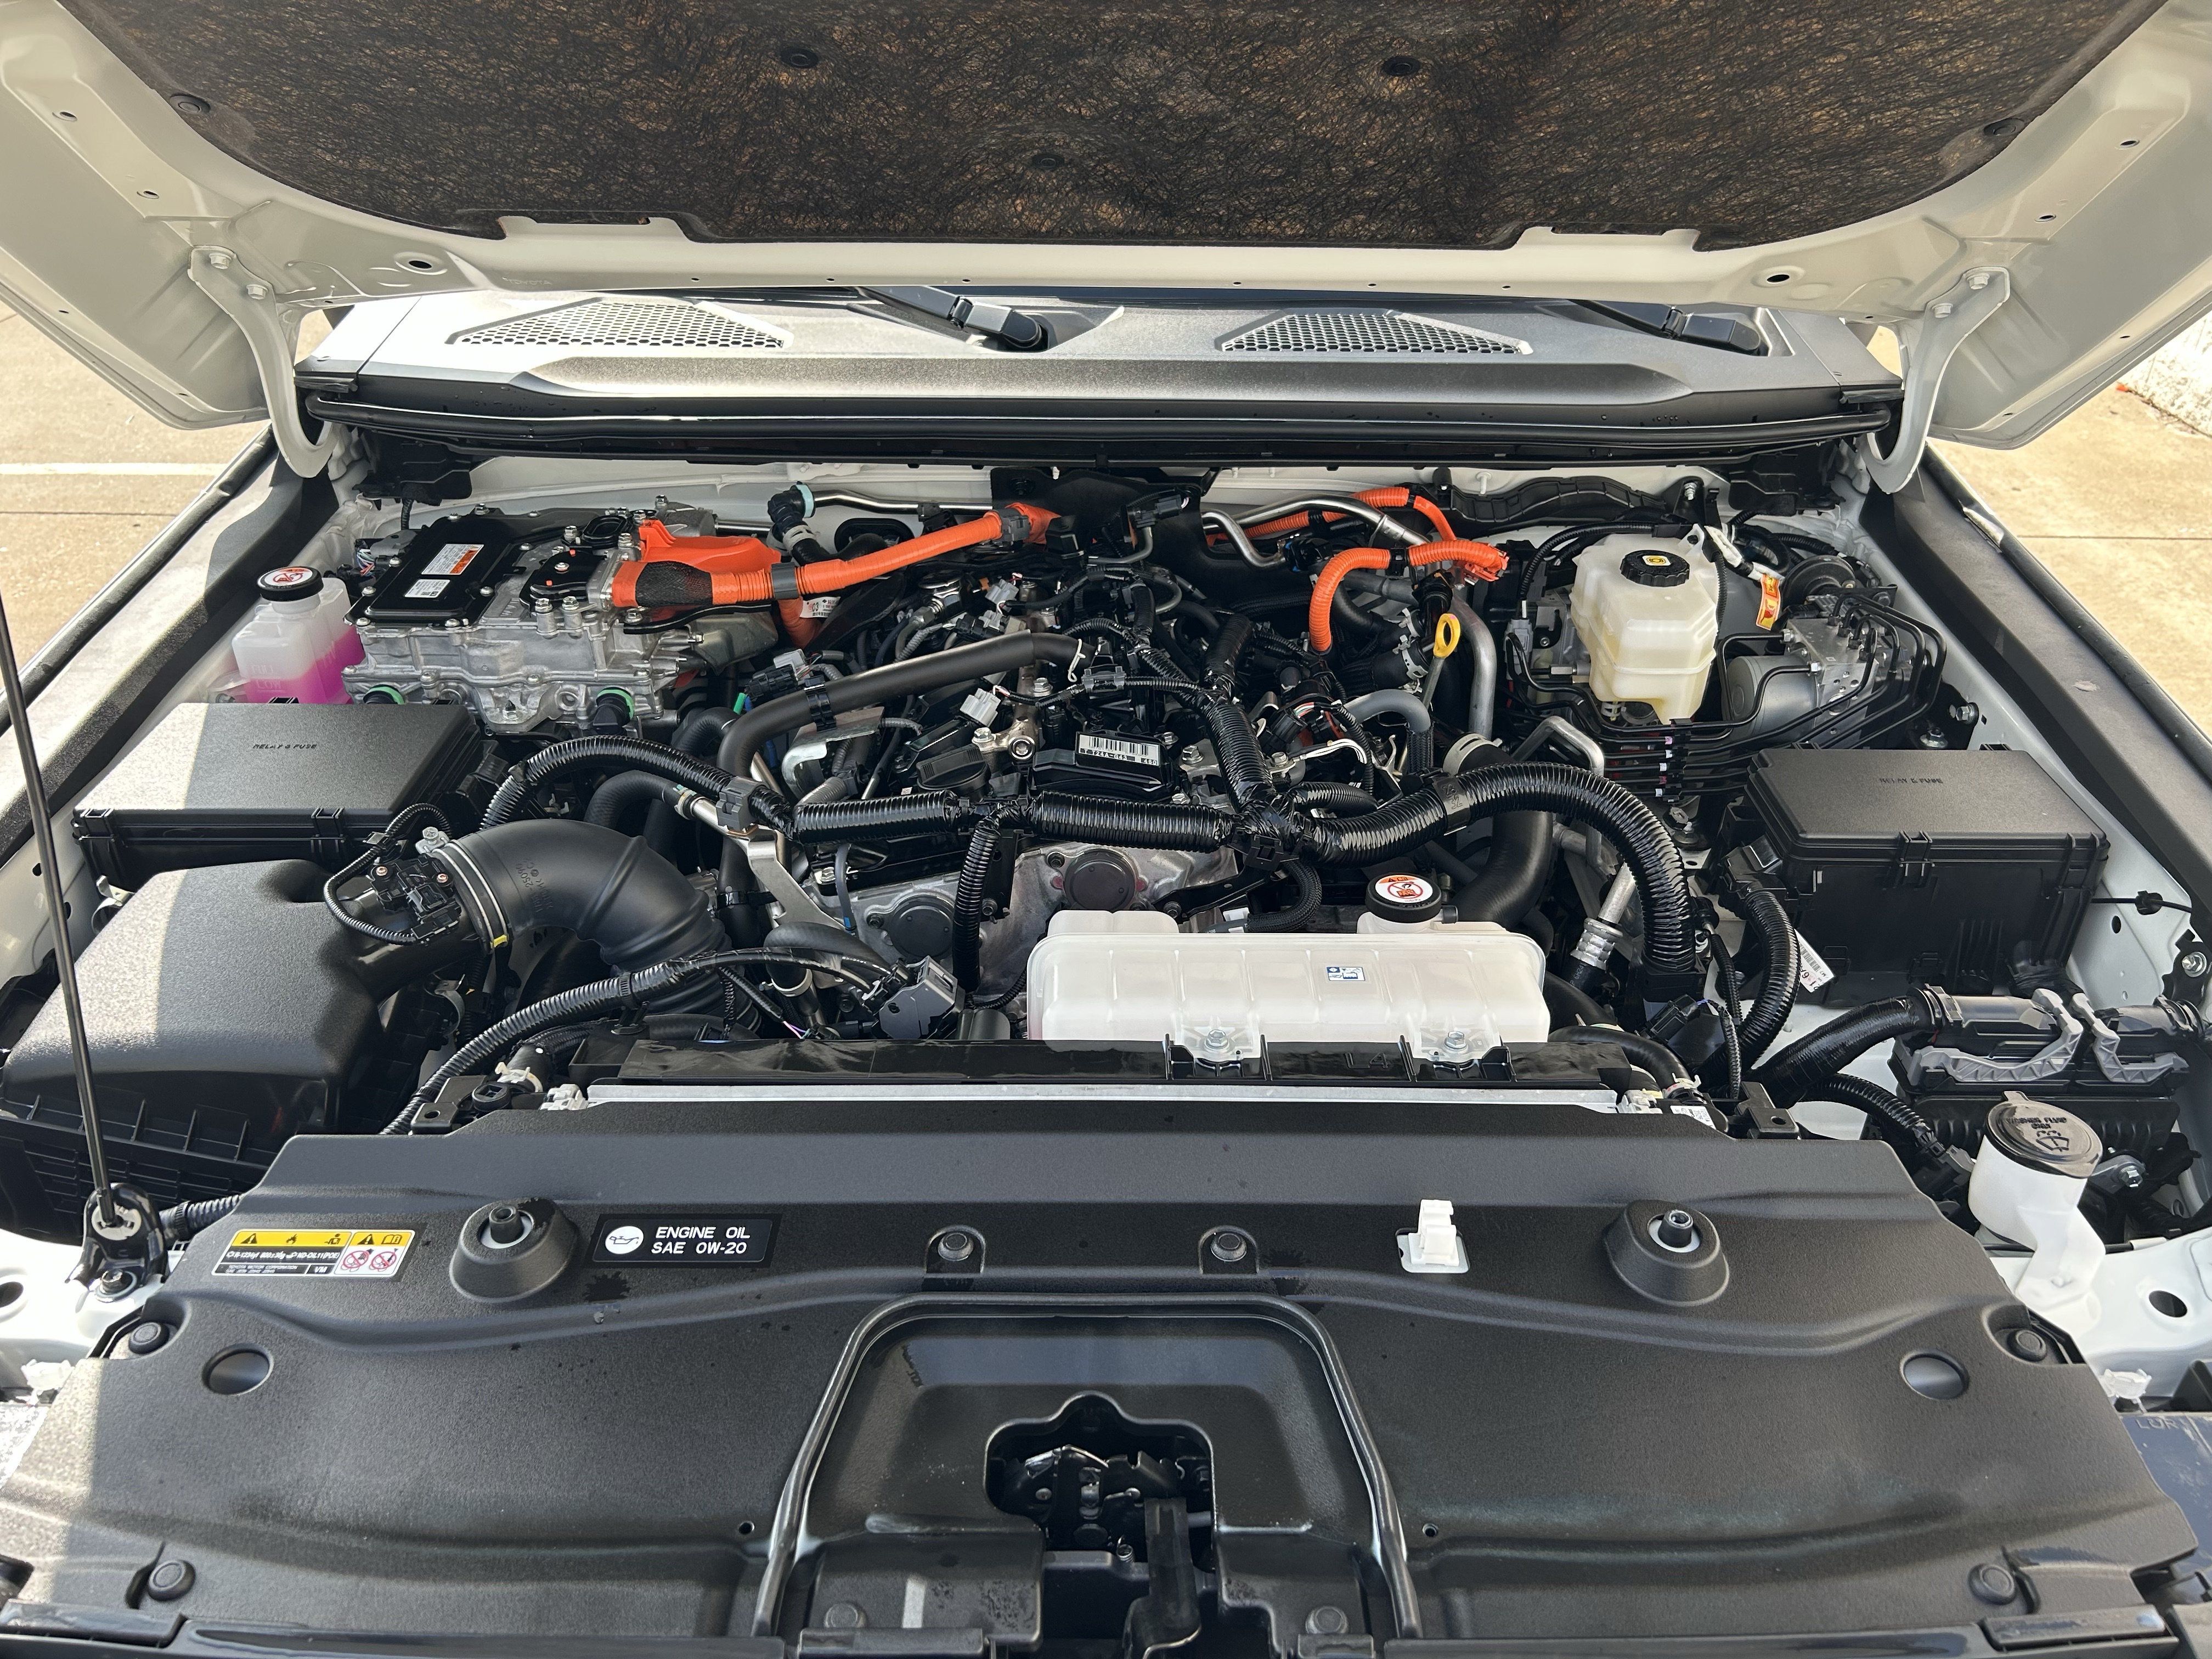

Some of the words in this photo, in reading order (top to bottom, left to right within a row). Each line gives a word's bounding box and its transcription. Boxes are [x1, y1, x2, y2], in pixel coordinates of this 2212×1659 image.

[656, 1227, 716, 1239] ENGINE
[726, 1227, 751, 1239] OIL
[651, 1242, 686, 1254] SAE
[696, 1242, 747, 1254] 0W-20
